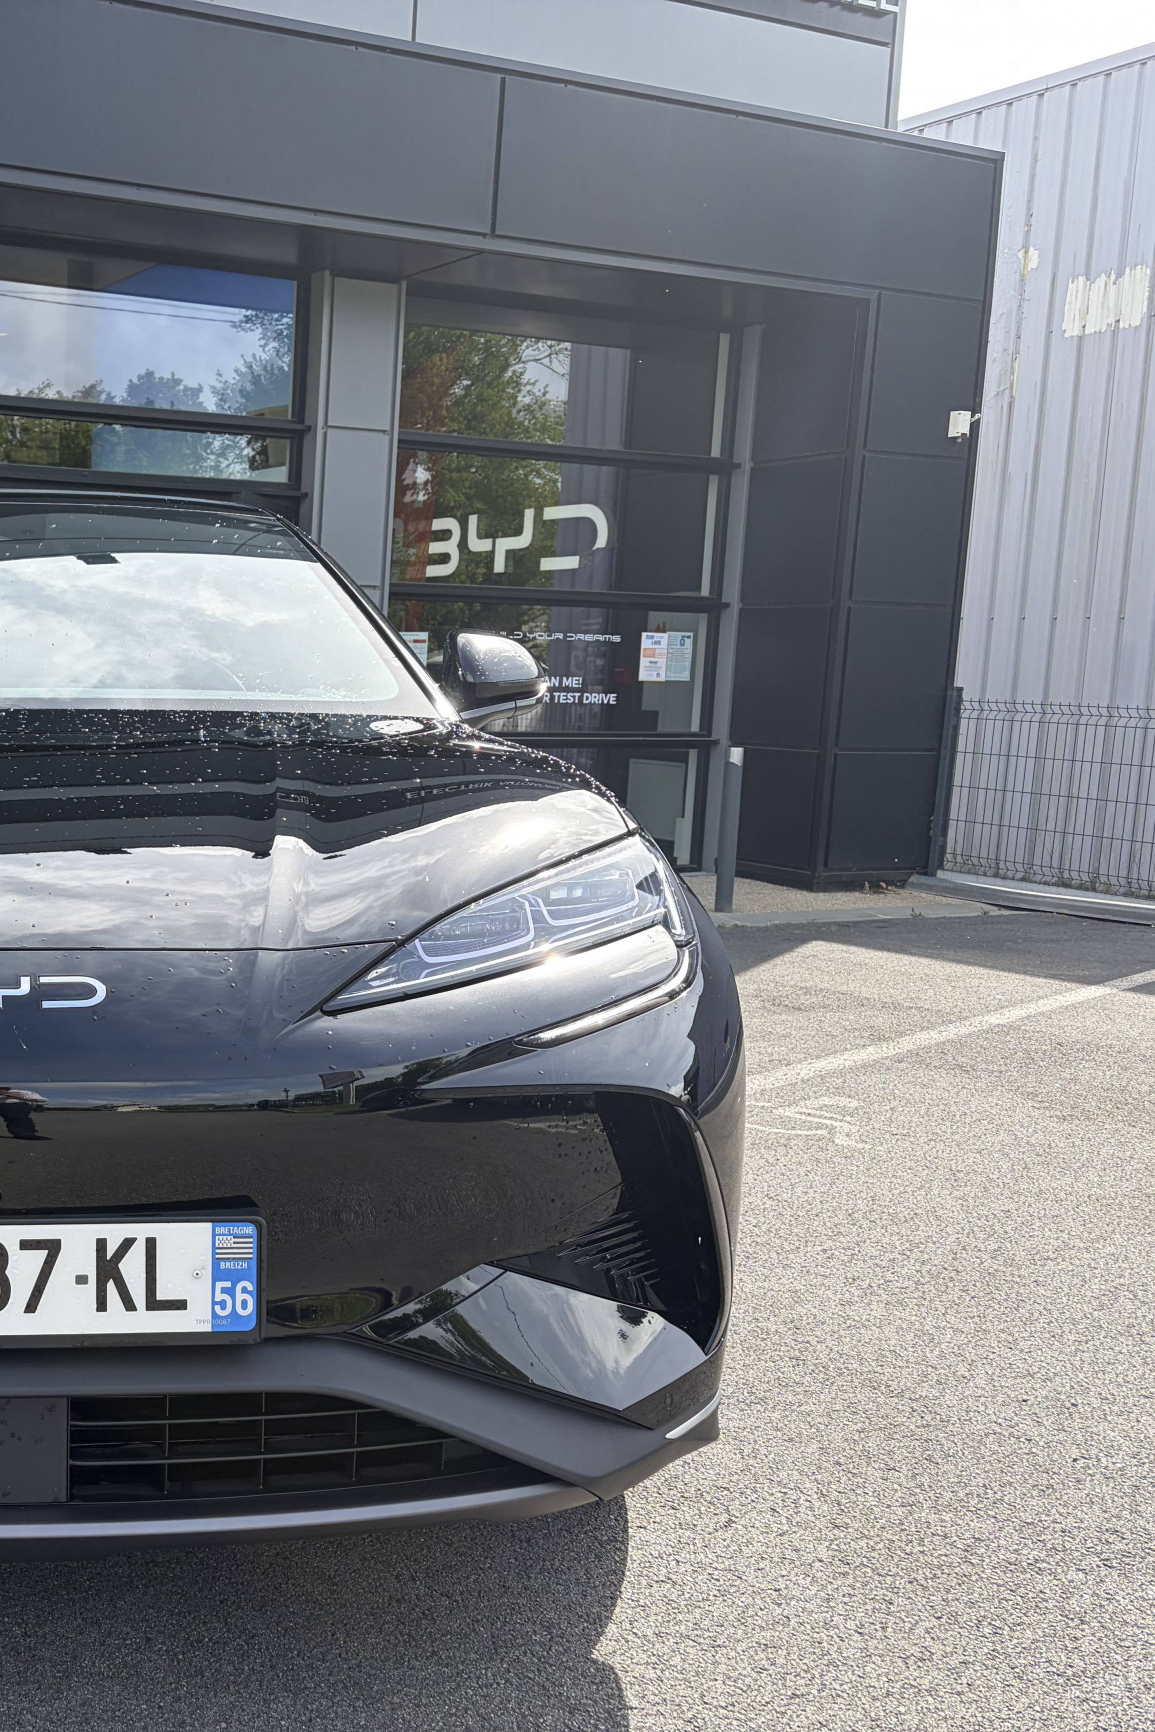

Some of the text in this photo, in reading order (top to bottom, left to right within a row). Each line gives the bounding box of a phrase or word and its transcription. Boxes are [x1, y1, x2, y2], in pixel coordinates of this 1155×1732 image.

[425, 503, 608, 577] BYD
[527, 632, 563, 640] YOUR
[567, 633, 622, 642] DREAMS
[562, 677, 582, 687] ME!
[553, 693, 581, 703] TEST
[583, 693, 617, 704] DRIVE
[215, 1226, 254, 1235] BRETAGNE
[220, 1261, 248, 1270] BREIZH
[214, 1280, 254, 1316] 56
